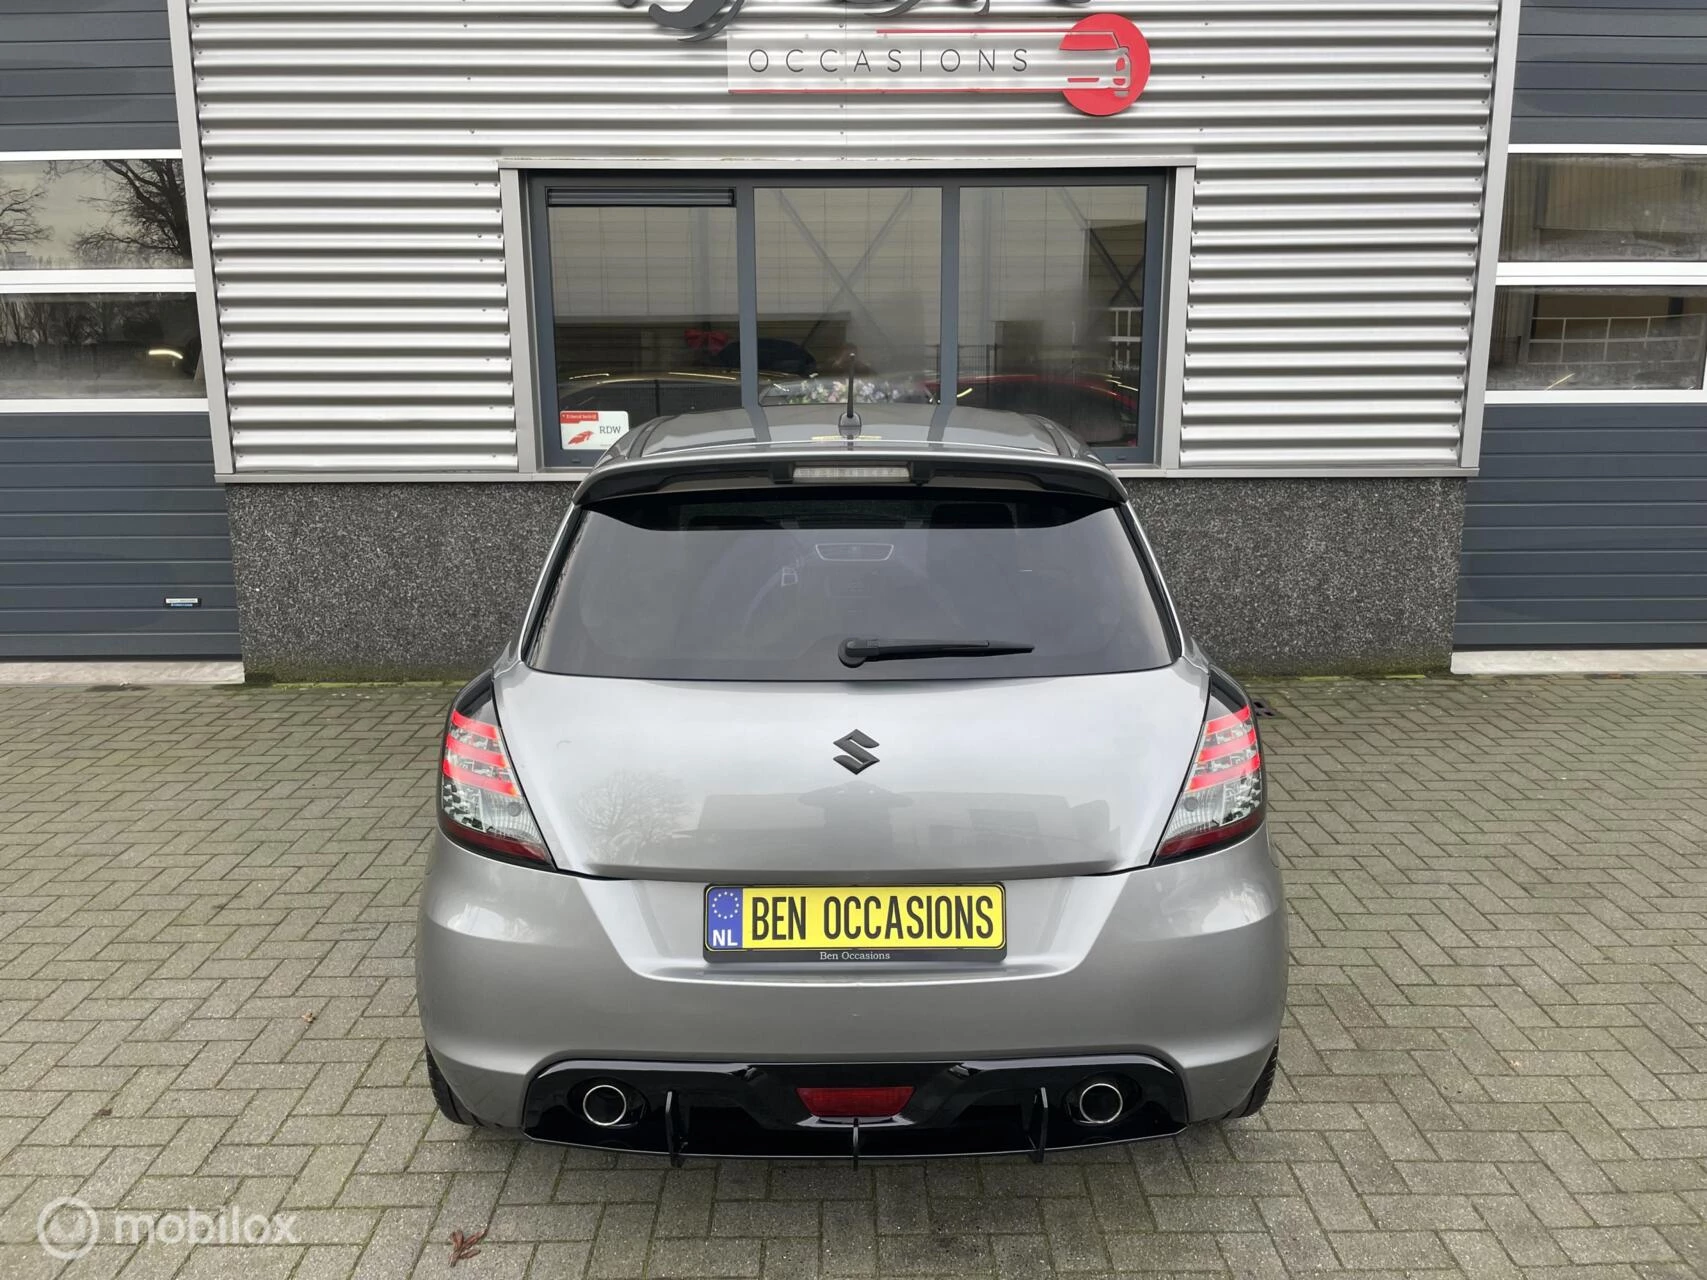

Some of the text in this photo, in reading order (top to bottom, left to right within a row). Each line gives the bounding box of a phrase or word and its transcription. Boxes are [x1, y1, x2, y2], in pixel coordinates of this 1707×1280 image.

[748, 48, 1029, 73] OCCASIONS
[599, 426, 621, 434] RDW
[752, 895, 993, 940] BEN OCCASIONS
[712, 929, 738, 946] NL
[820, 951, 891, 960] Ben Occasions
